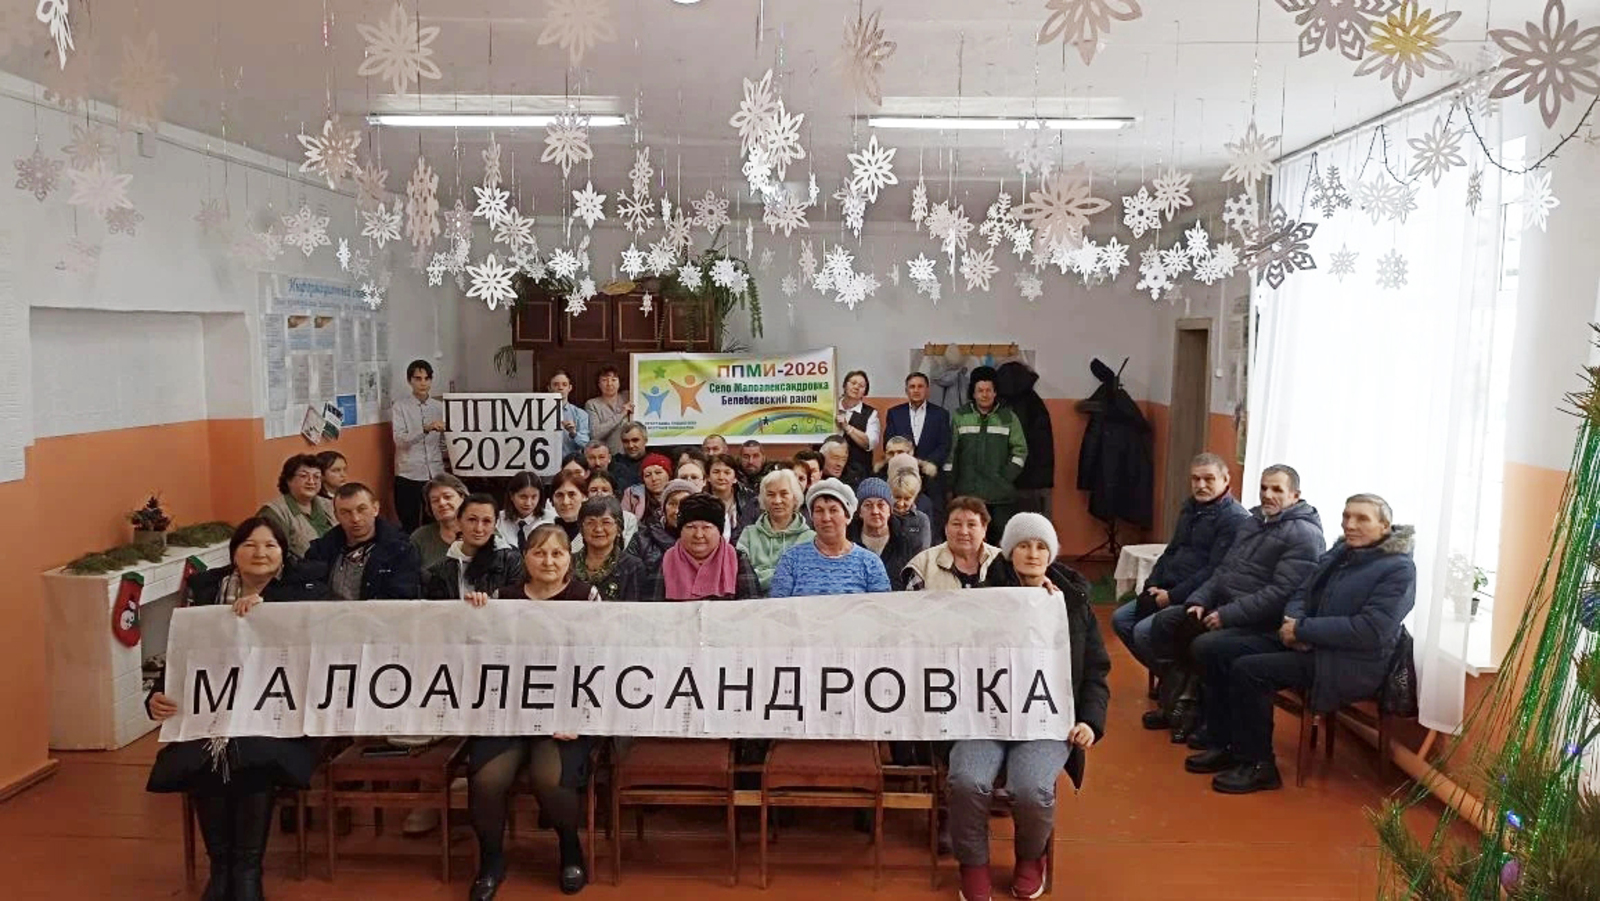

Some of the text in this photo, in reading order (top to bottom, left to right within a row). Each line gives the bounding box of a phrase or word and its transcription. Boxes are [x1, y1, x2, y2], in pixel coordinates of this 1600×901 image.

[717, 361, 828, 378] ППМИ-2026
[709, 381, 829, 393] Село Малоалександровка
[790, 394, 818, 405] район
[443, 398, 563, 432] ППМИ
[452, 436, 550, 471] 2026
[193, 664, 1059, 721] МАЛОАЛЕКСАНДРОВКА
